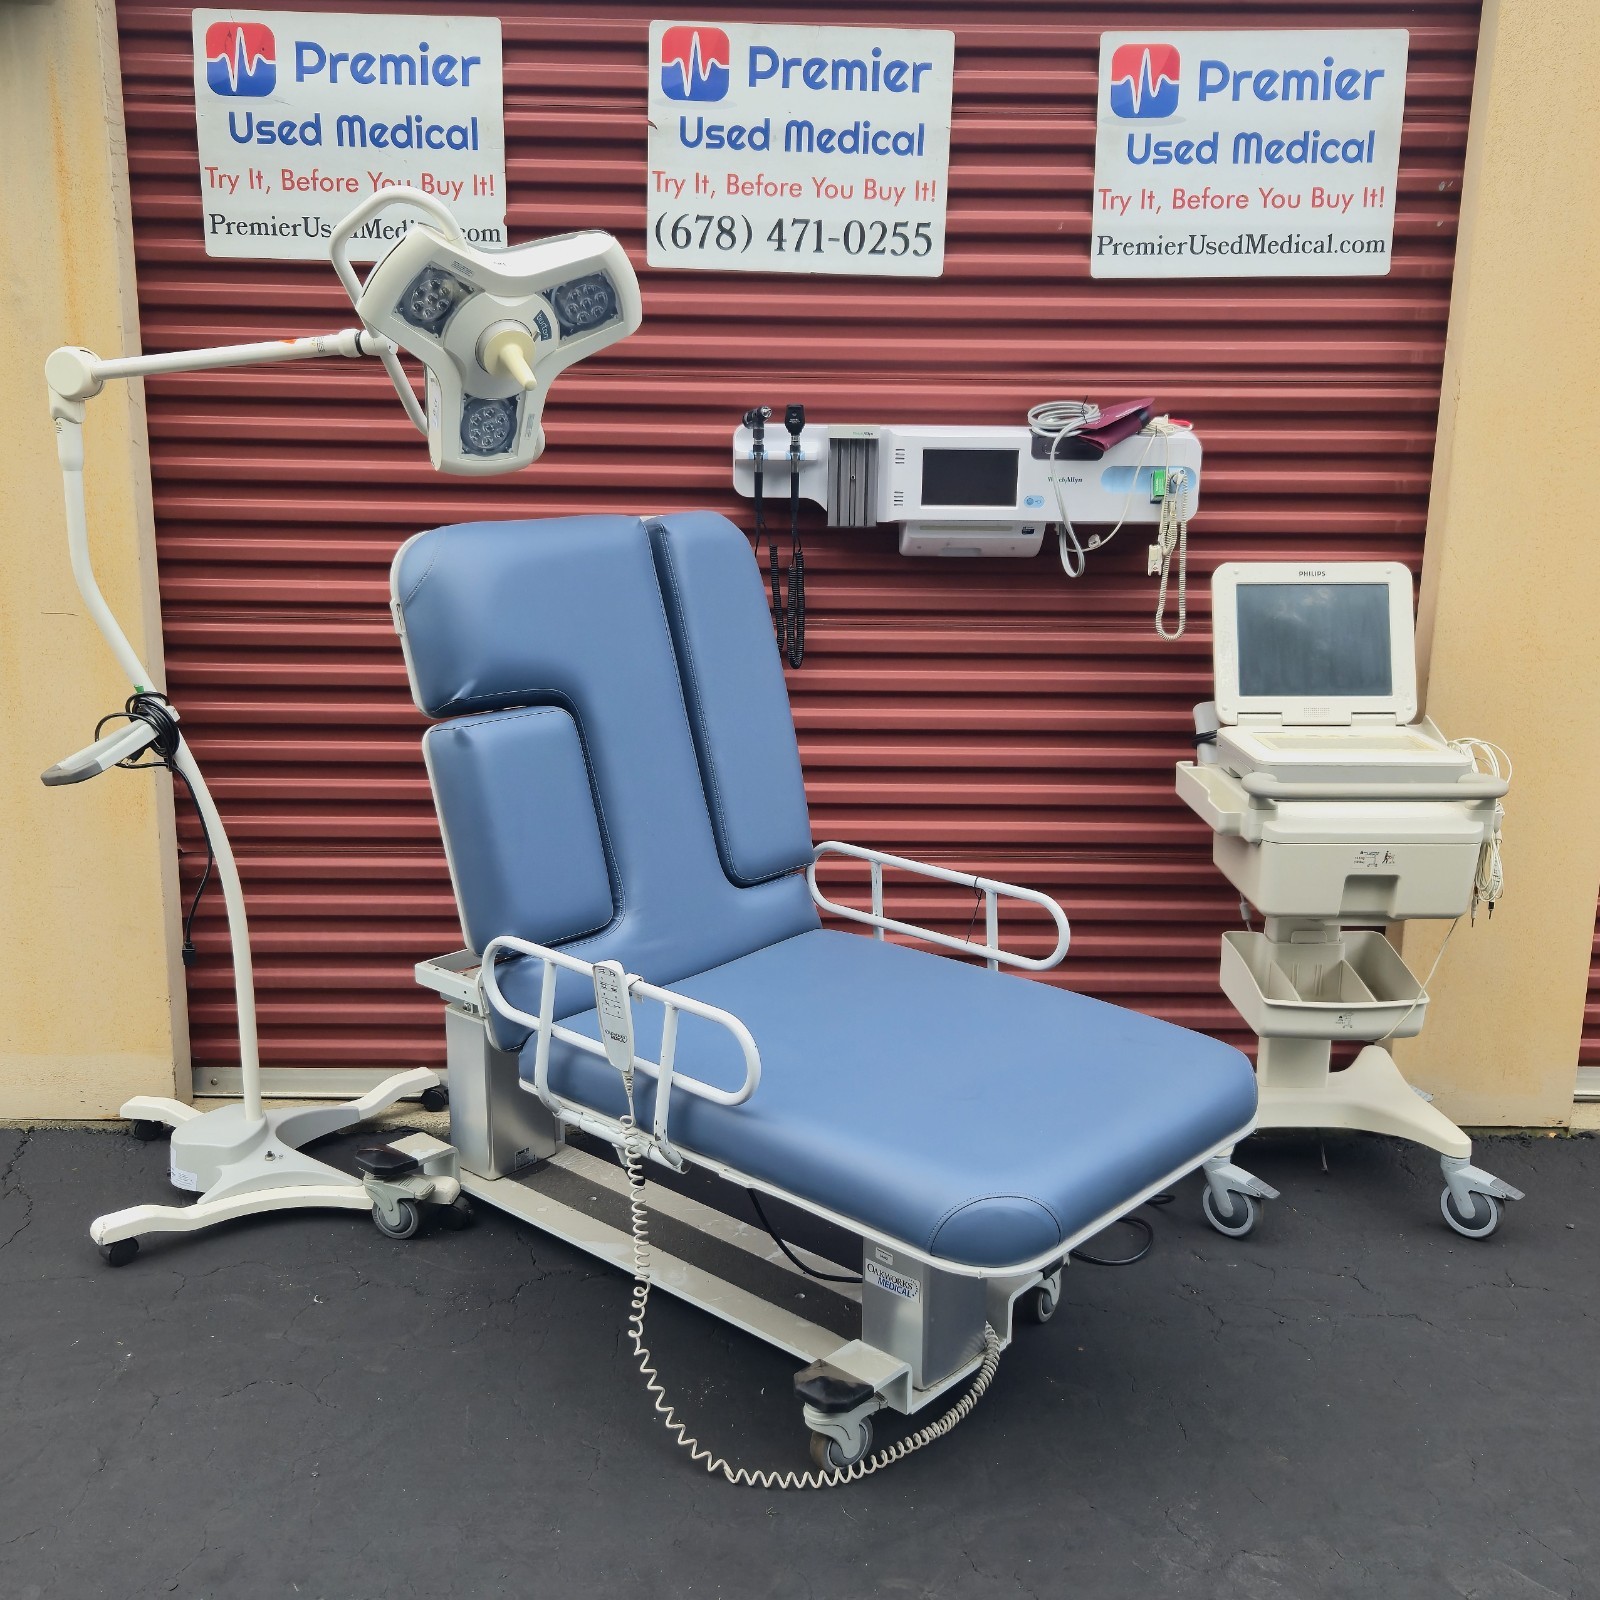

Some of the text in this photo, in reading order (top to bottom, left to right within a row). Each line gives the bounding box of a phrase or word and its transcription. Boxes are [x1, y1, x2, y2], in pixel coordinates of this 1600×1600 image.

[294, 40, 481, 88] Premier
[748, 46, 933, 94] Premier
[1198, 56, 1385, 103] Premier
[229, 111, 479, 151] Used Medical
[679, 116, 925, 157] Used Medical
[1126, 129, 1376, 166] Used Medical
[204, 166, 240, 195] Try
[248, 168, 271, 195] It,
[281, 168, 359, 193] Before
[421, 172, 464, 201] Buy
[473, 174, 495, 197] It!
[652, 170, 937, 207] Try It, Before You Buy It!
[1098, 185, 1386, 216] Try It, Before You Buy It!
[654, 211, 933, 258] (678) 471-0255
[1096, 233, 1386, 257] PremierUsedMedical.com
[537, 312, 549, 339] burton
[866, 1263, 913, 1291] OAKWORKS
[877, 1277, 912, 1298] MEDICAL
